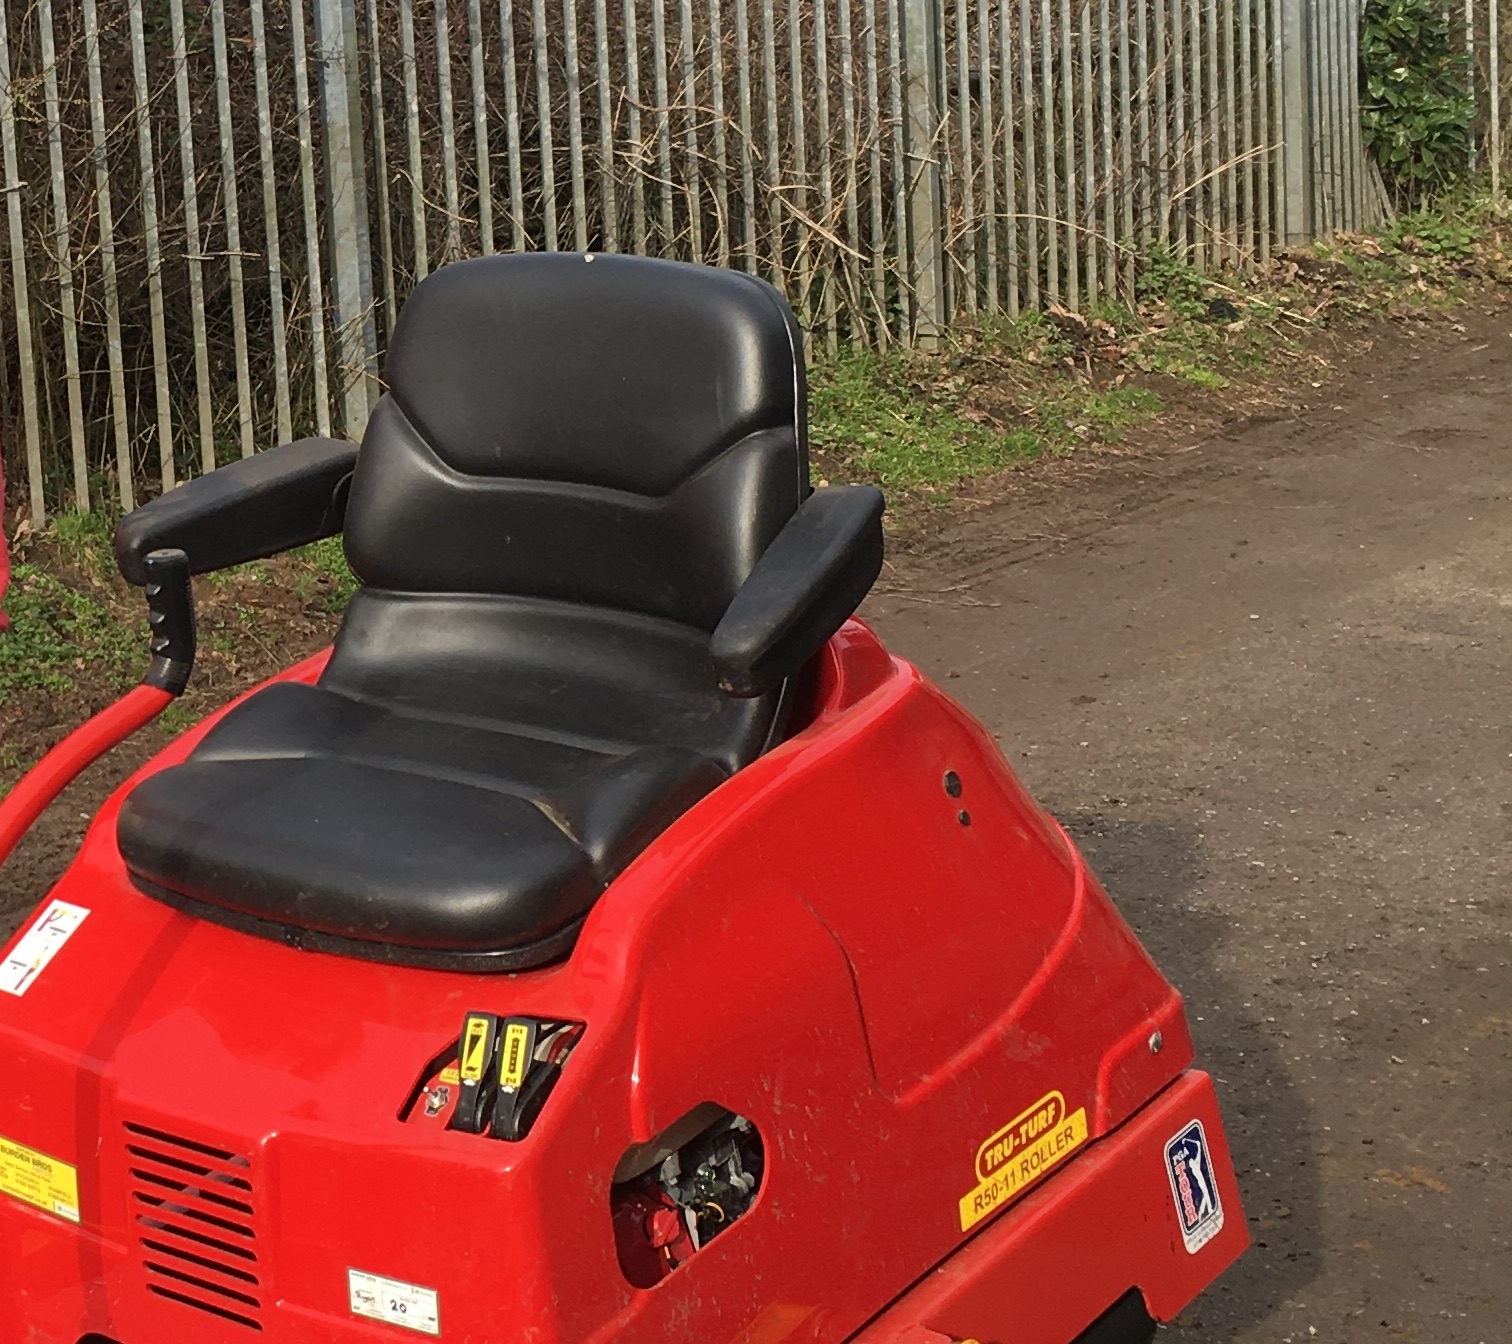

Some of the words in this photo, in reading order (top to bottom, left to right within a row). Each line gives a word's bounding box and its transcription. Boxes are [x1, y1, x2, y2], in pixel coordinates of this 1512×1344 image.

[0, 1144, 30, 1164] BURDEN
[974, 1168, 1016, 1214] R50-11
[1020, 1125, 1075, 1179] ROLLER
[984, 1102, 1056, 1171] TRU-TURF
[1174, 1160, 1198, 1227] TOUR
[390, 1299, 407, 1314] 20
